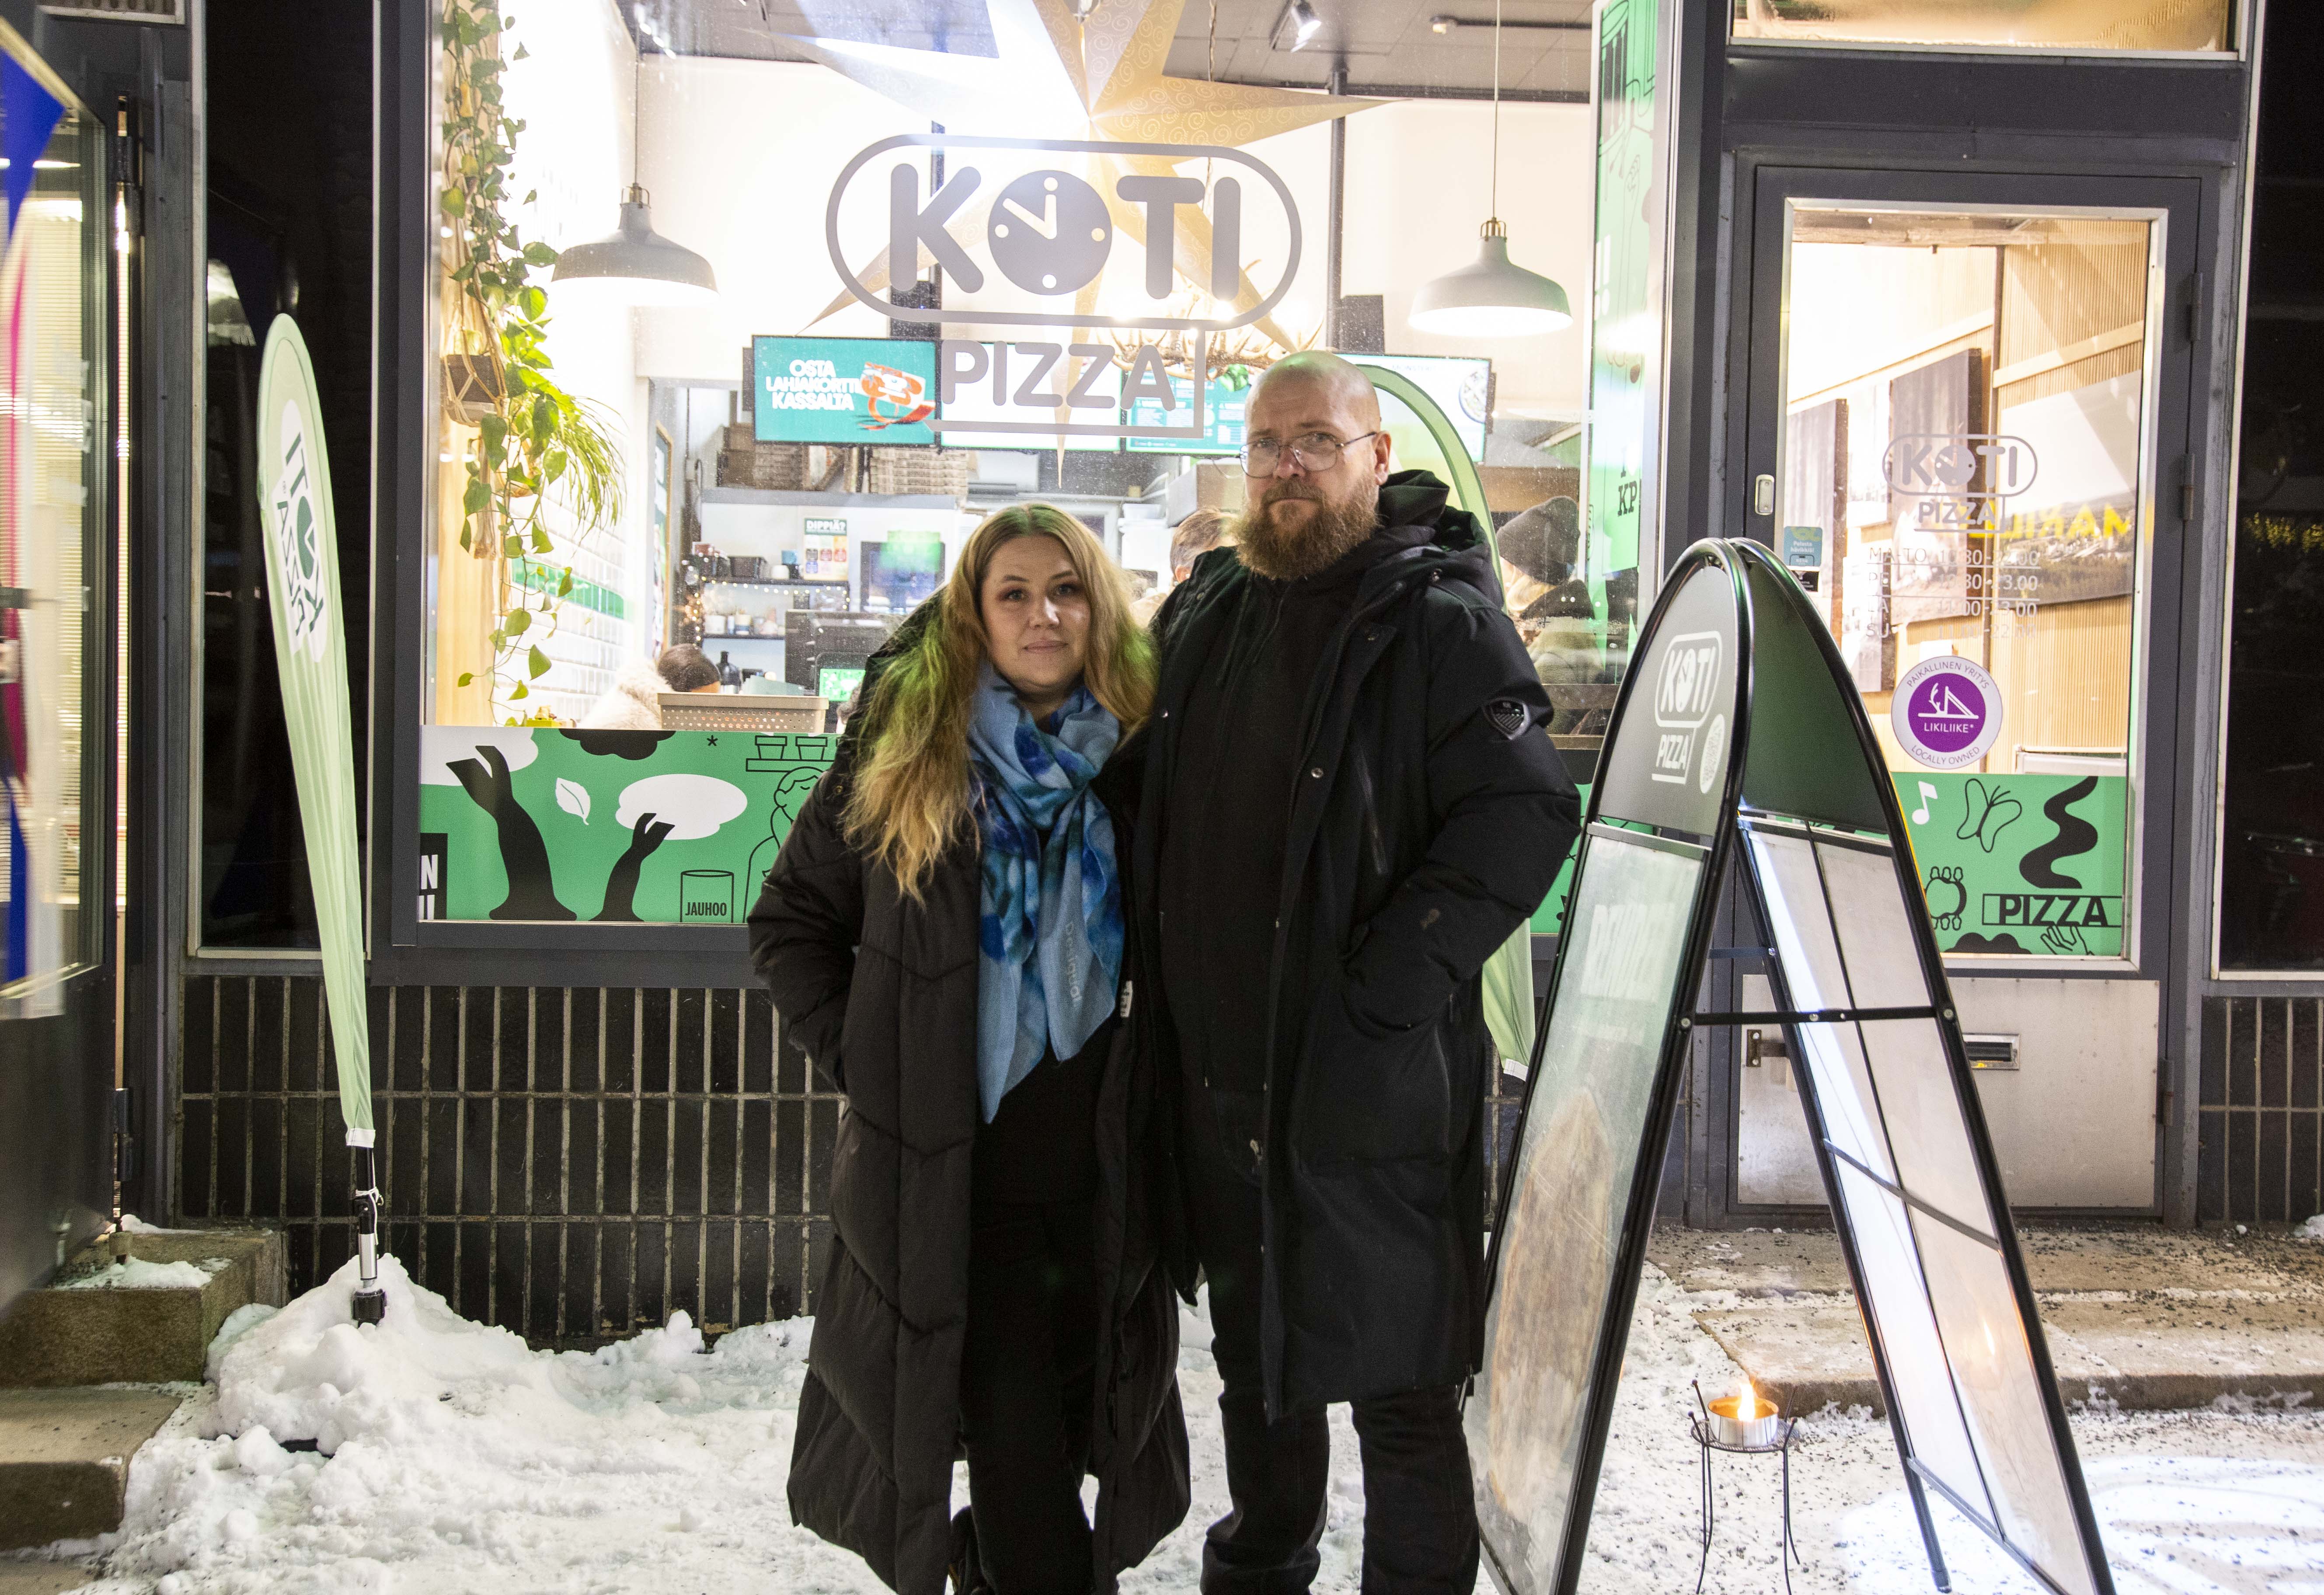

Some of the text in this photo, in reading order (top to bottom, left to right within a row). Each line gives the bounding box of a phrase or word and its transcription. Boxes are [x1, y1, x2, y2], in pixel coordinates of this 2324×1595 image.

[890, 163, 1241, 301] KOTI
[789, 359, 836, 378] OSTA
[941, 339, 1176, 411] PIZZA
[772, 392, 854, 411] KASSALTA
[1902, 443, 2017, 488] KOTI
[1618, 481, 1637, 517] KP
[1918, 501, 1995, 525] PIZZA
[806, 519, 846, 530] DIPPIÄ?
[1869, 547, 1927, 563] MA-TO
[1869, 572, 1889, 588] PE
[1868, 598, 1889, 613] LA
[1866, 623, 1889, 638] SU
[1661, 646, 1716, 713] KOTI
[1907, 661, 1989, 689] PAIKALLINEN YRITYS
[1924, 722, 1969, 733] LIKILIIKE
[1656, 734, 1689, 770] PIZZA
[1911, 745, 1980, 764] LOCALLY OWNED
[685, 902, 727, 916] JAUHOO
[1999, 895, 2108, 926] PIZZA
